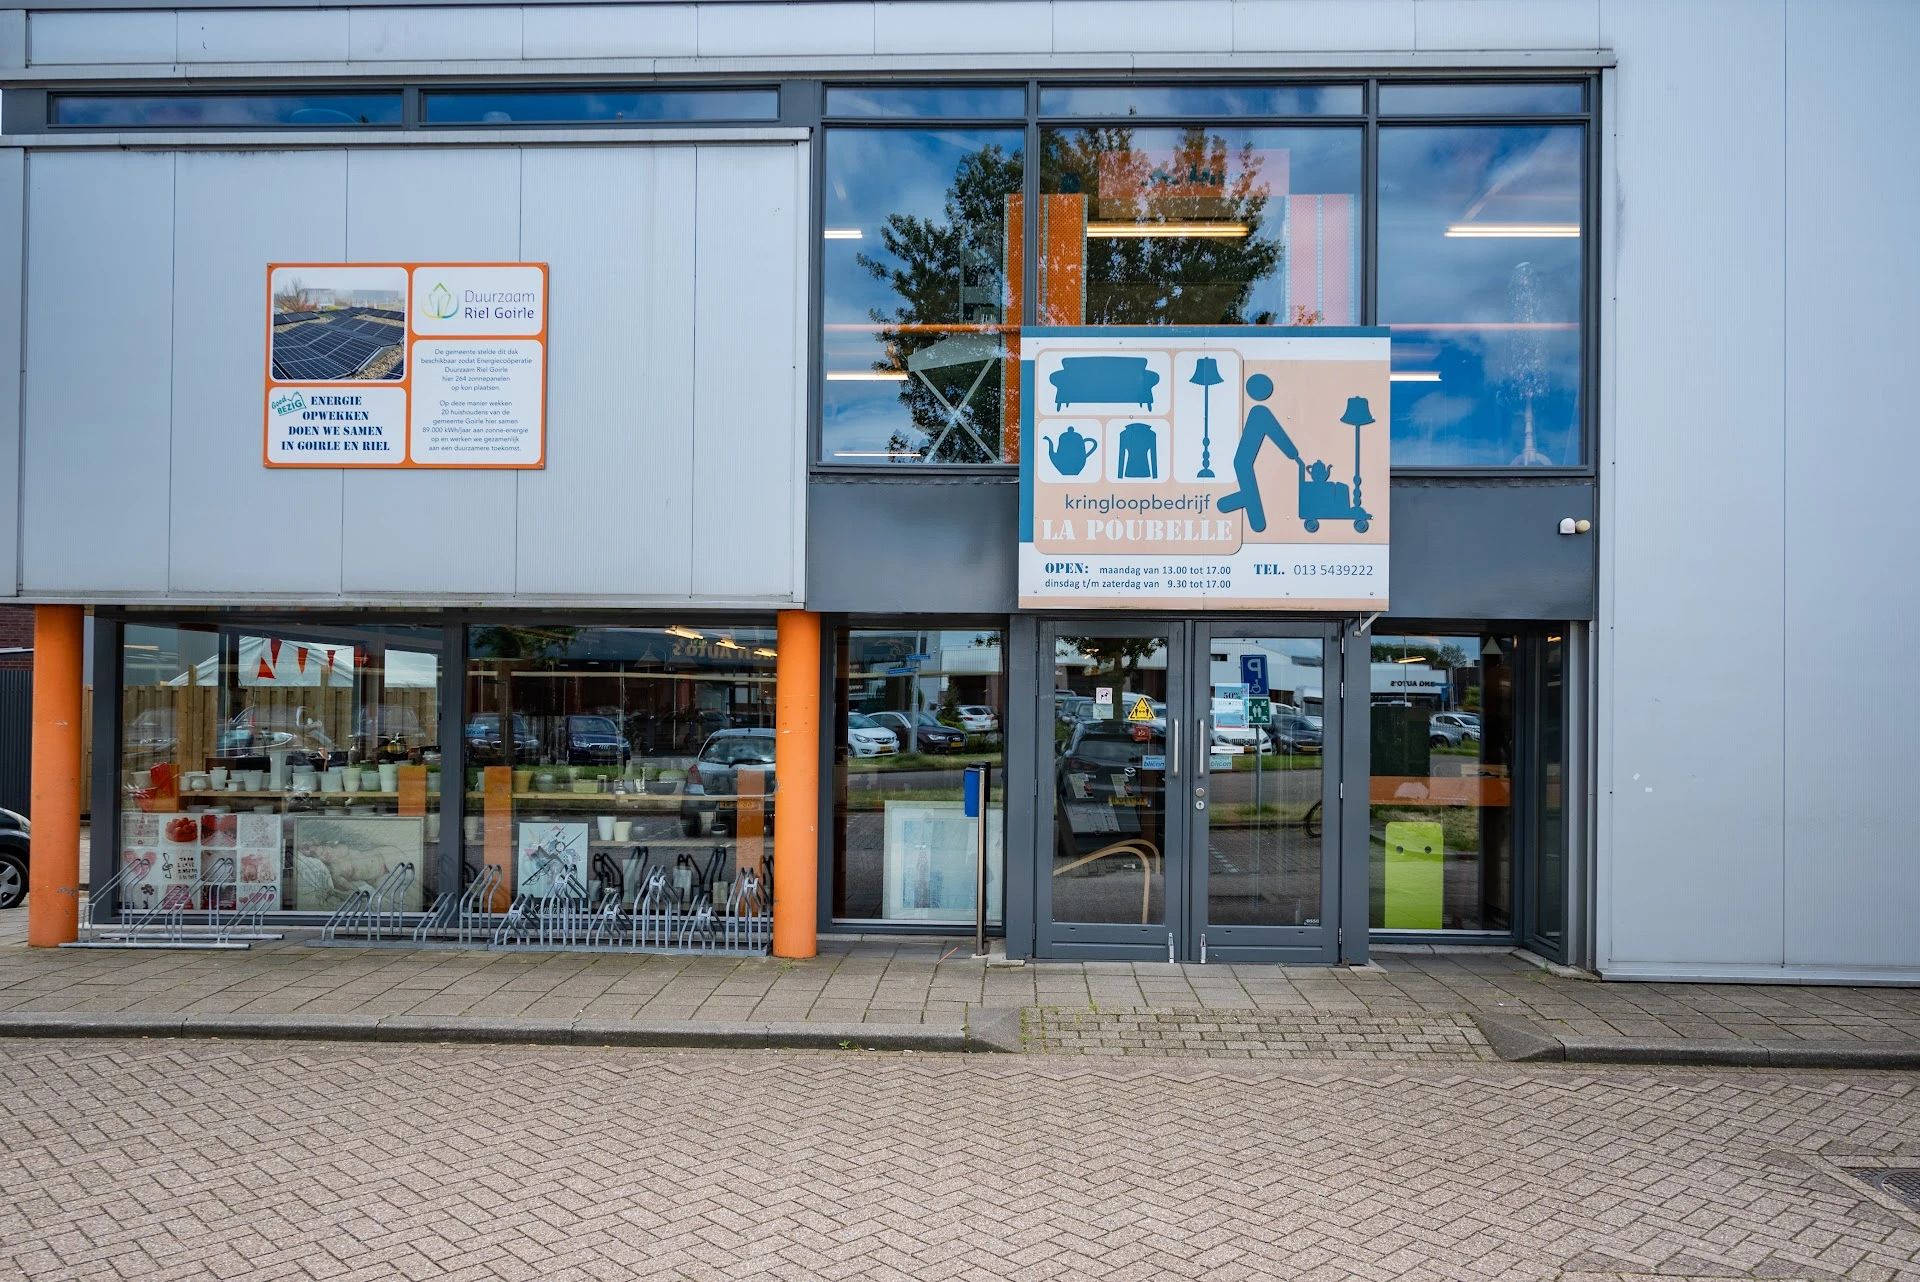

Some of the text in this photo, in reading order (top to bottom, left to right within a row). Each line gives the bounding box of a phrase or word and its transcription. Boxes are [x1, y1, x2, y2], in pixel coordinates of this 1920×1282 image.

[465, 290, 535, 303] Duurzaam
[464, 306, 535, 319] Riel Goirle
[477, 358, 532, 366] Energiecoöperatie
[272, 394, 287, 410] Good
[311, 396, 362, 405] ENERGIE
[277, 400, 303, 415] BEZIG
[302, 411, 369, 420] OPWEKKEN
[288, 426, 383, 435] DOEN WE SAMEN
[281, 441, 390, 450] IN GOIRLE EN RIEL
[1065, 494, 1211, 514] kringloopbedrijf
[1042, 520, 1232, 541] LA POUBELLE
[1045, 562, 1089, 574] OPEN:
[1099, 566, 1141, 576] maandag
[1162, 567, 1187, 575] 13.00
[1190, 567, 1203, 575] tot
[1206, 567, 1231, 575] 17.00
[1254, 564, 1373, 576] TEL. 013 5439222
[1045, 580, 1080, 589] dinsdag
[1082, 579, 1099, 588] t/m
[1102, 580, 1141, 589] zaterdag
[1167, 580, 1187, 588] 9.30
[1206, 580, 1231, 588] 17.00
[1210, 760, 1232, 768] blicon
